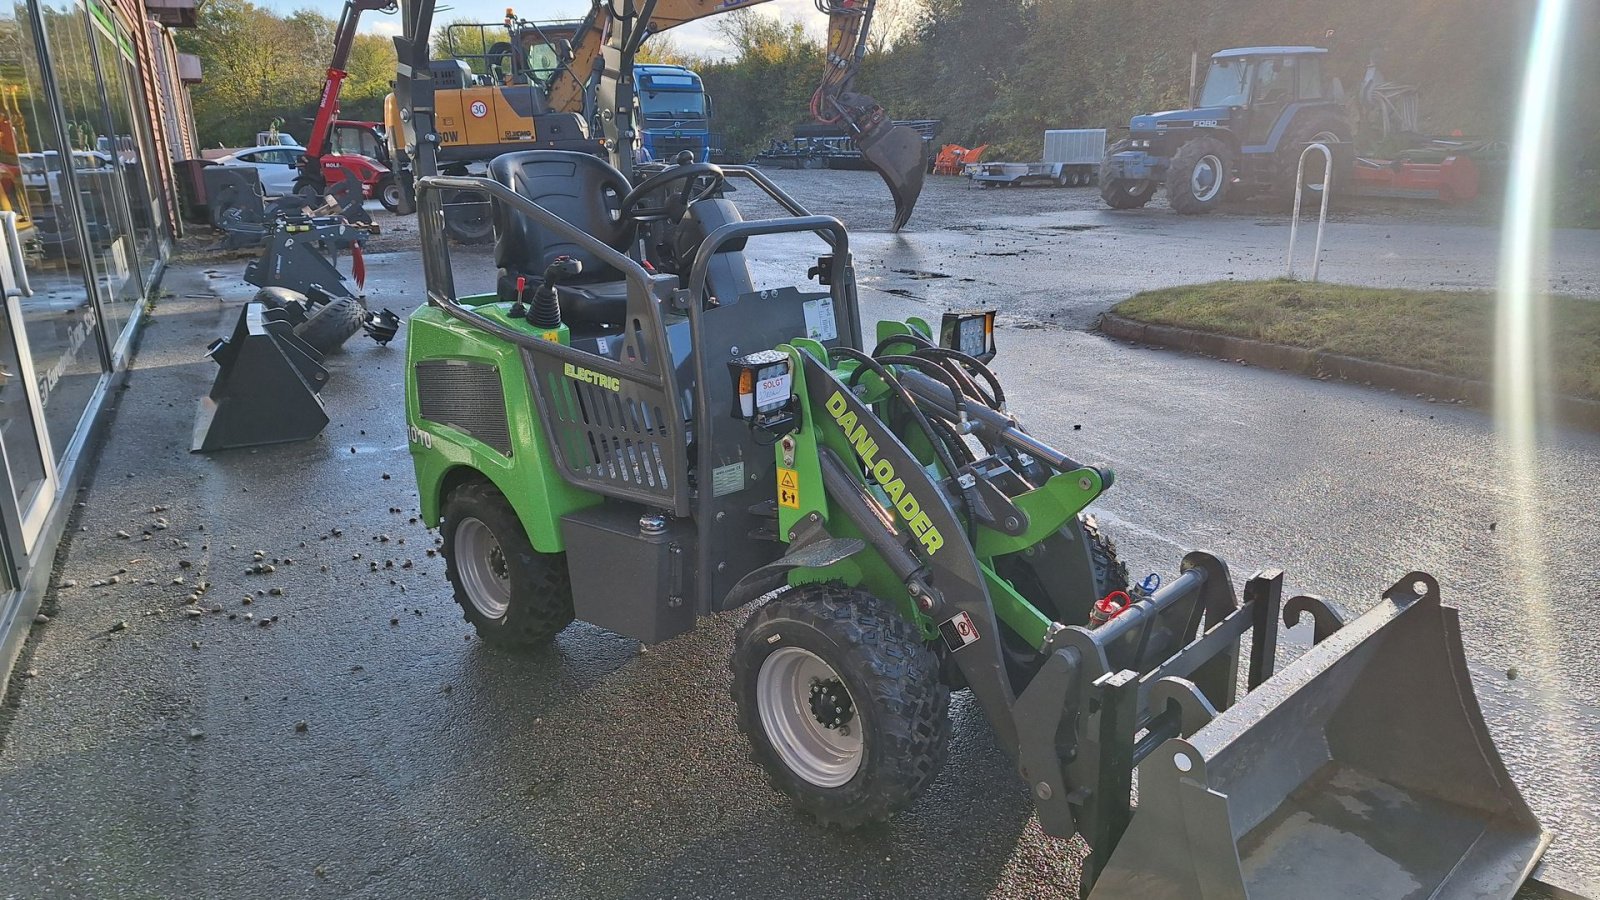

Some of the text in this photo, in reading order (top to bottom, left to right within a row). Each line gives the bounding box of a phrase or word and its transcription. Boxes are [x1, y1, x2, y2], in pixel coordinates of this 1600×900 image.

[472, 104, 485, 114] 30
[564, 362, 620, 392] ELECTRIC
[762, 377, 784, 390] SOLGT
[825, 390, 944, 556] DANLOADER
